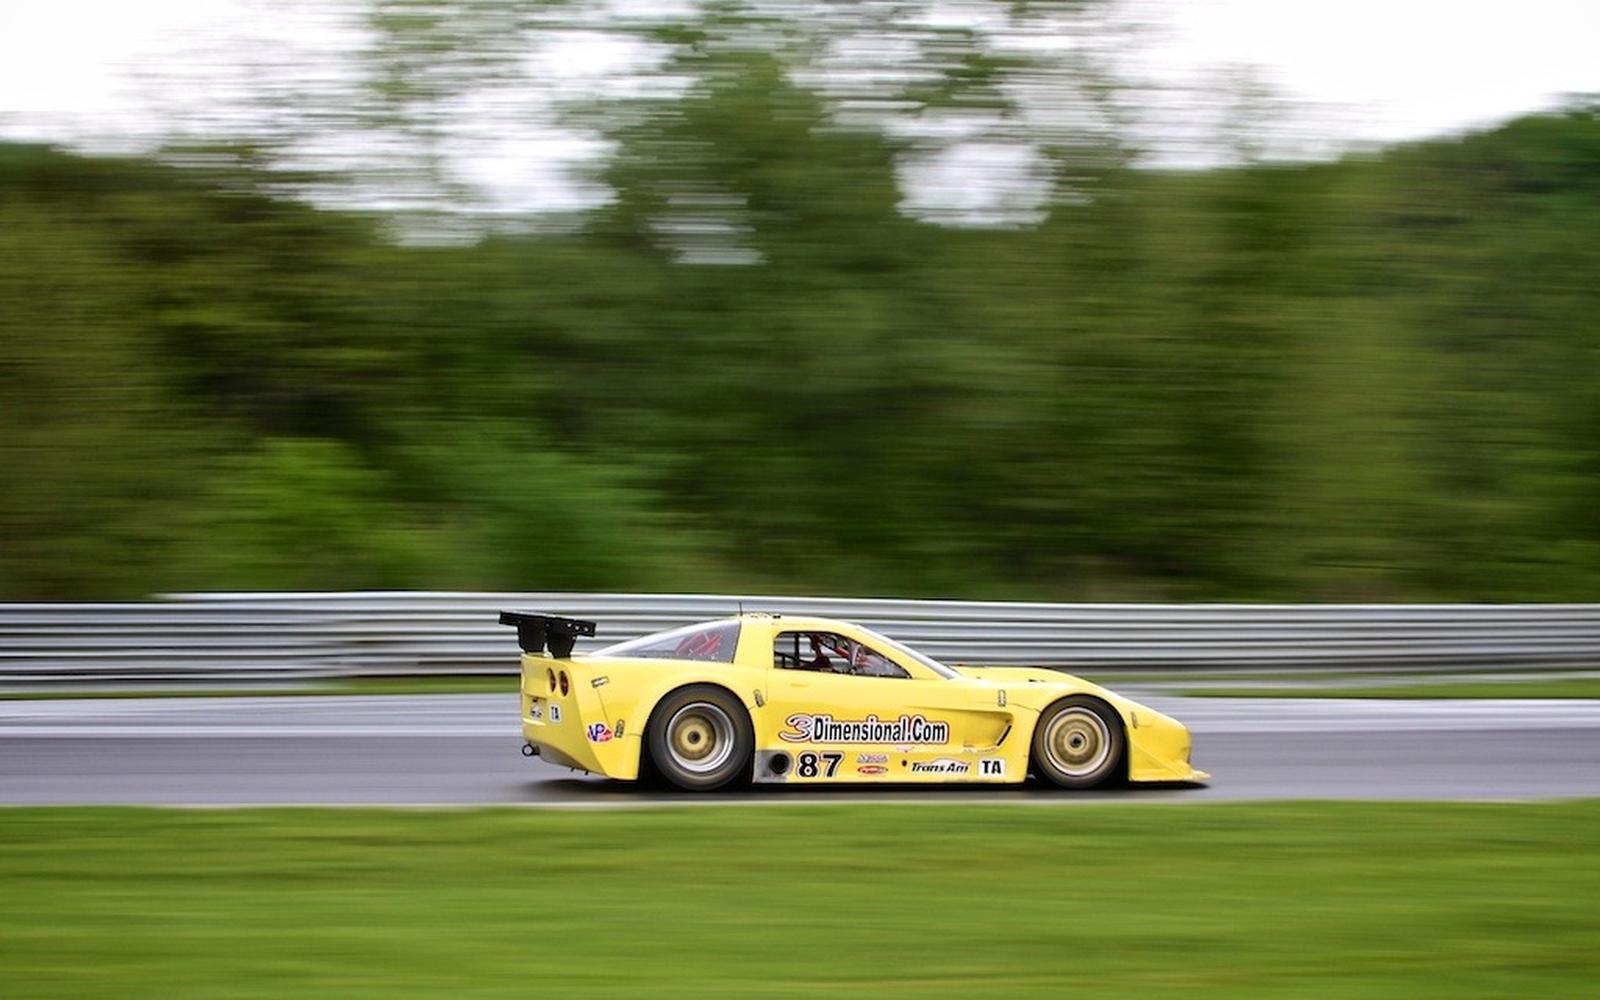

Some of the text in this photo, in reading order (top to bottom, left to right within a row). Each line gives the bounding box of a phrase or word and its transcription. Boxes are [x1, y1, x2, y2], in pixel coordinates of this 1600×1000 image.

[588, 723, 605, 742] VP
[780, 715, 947, 742] 3Dimensional.Com
[799, 753, 842, 777] 87
[911, 762, 969, 773] Trans Am
[982, 760, 1001, 774] TA
